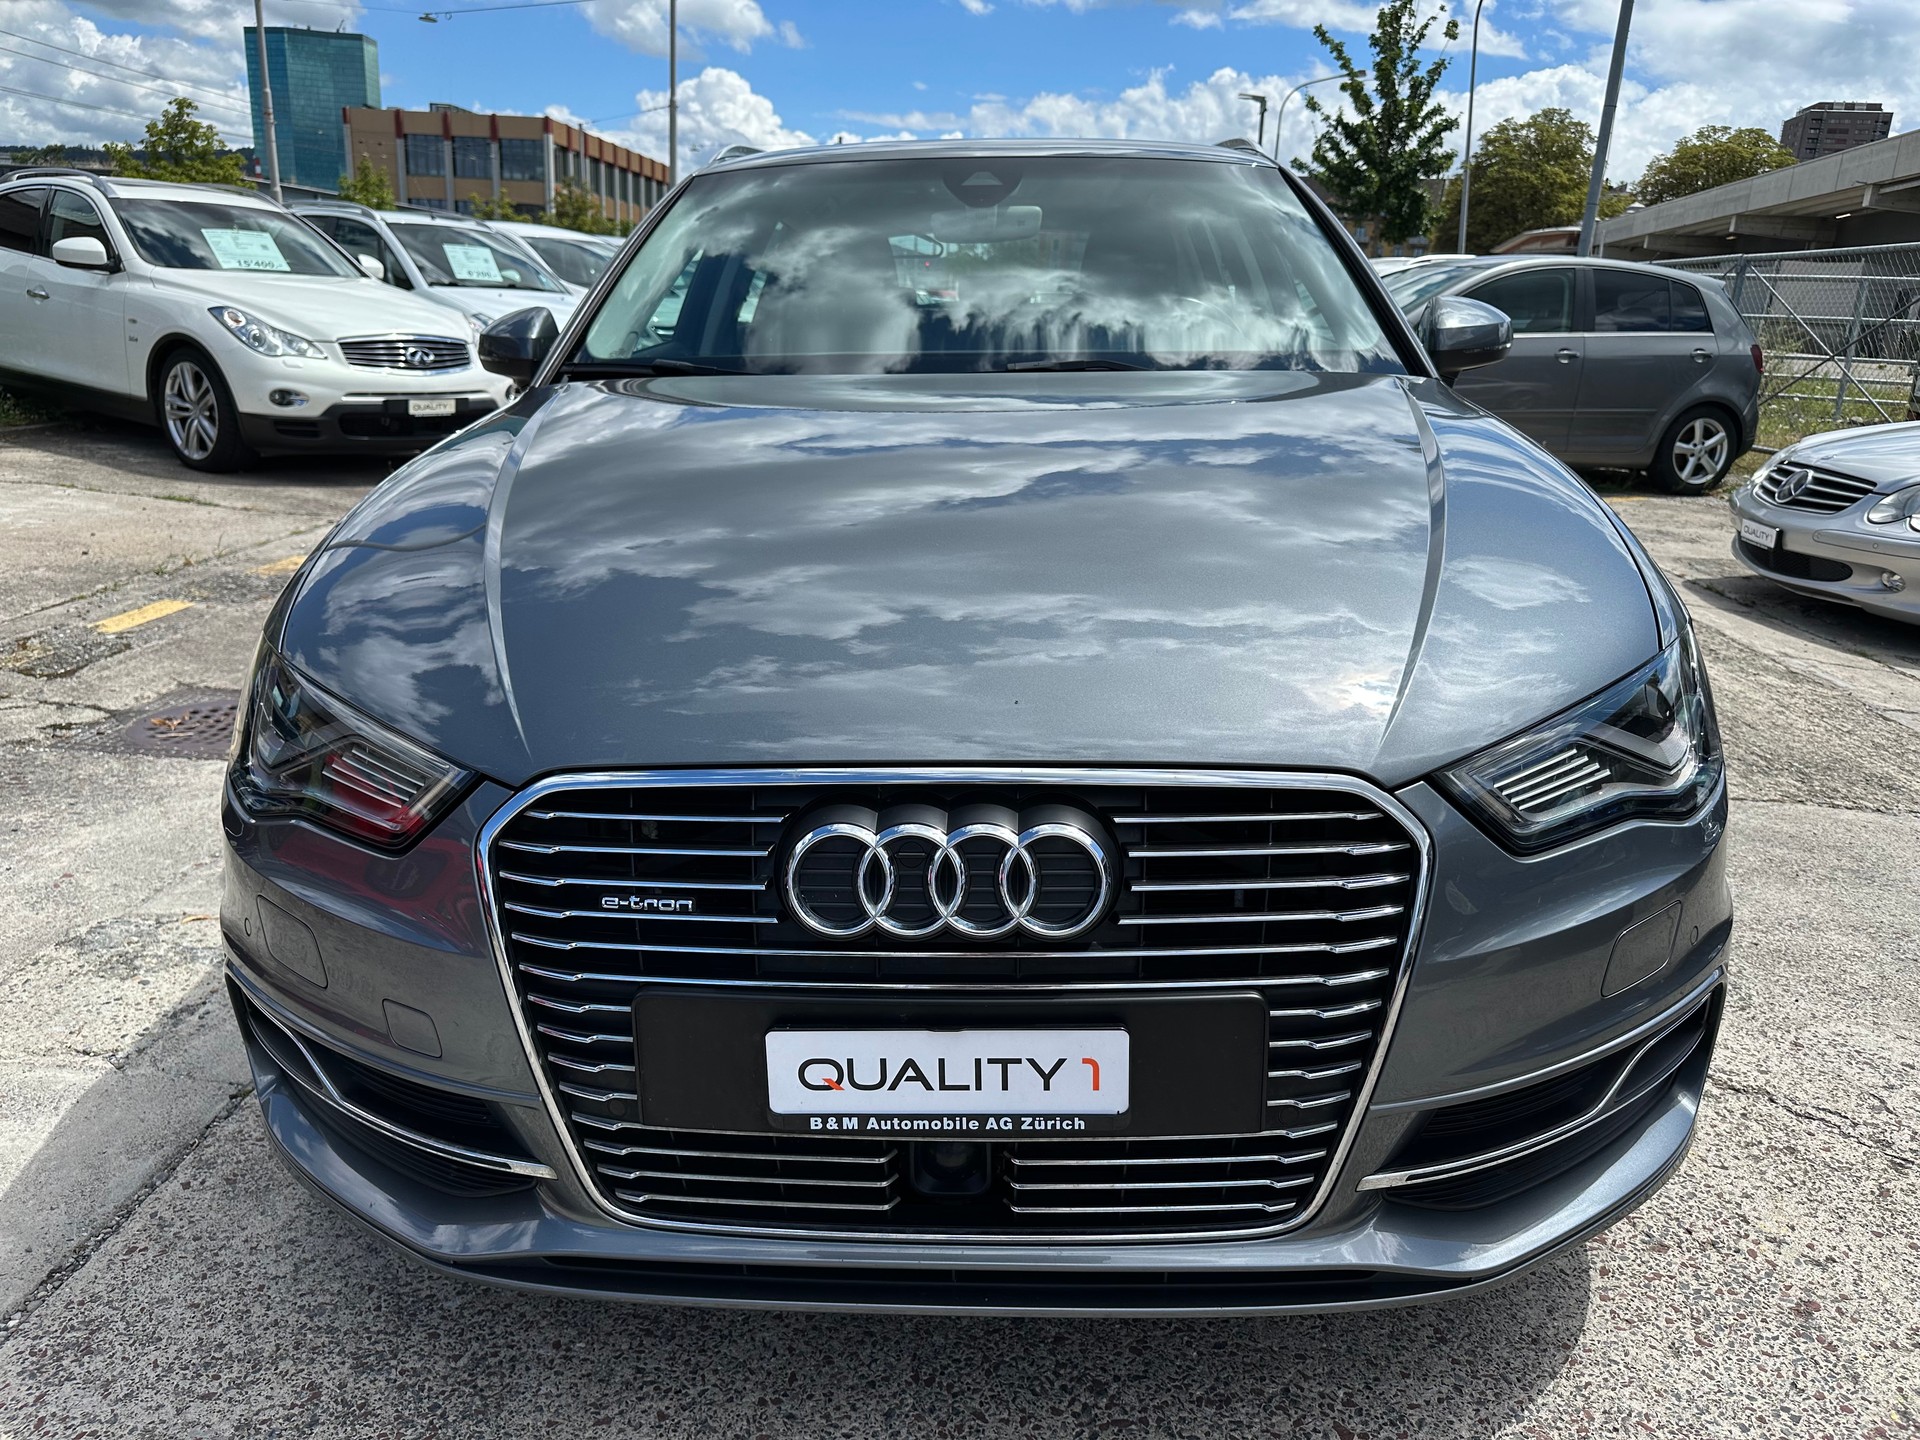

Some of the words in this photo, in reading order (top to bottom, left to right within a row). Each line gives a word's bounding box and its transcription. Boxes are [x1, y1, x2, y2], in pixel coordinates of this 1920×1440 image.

[1743, 525, 1769, 542] QUALITY
[601, 895, 693, 912] e-tron
[797, 1057, 1068, 1091] QUALITY
[1081, 1057, 1100, 1091] 1
[866, 1116, 980, 1130] Automobile
[986, 1116, 1013, 1130] AG
[1020, 1115, 1086, 1130] Zürich
